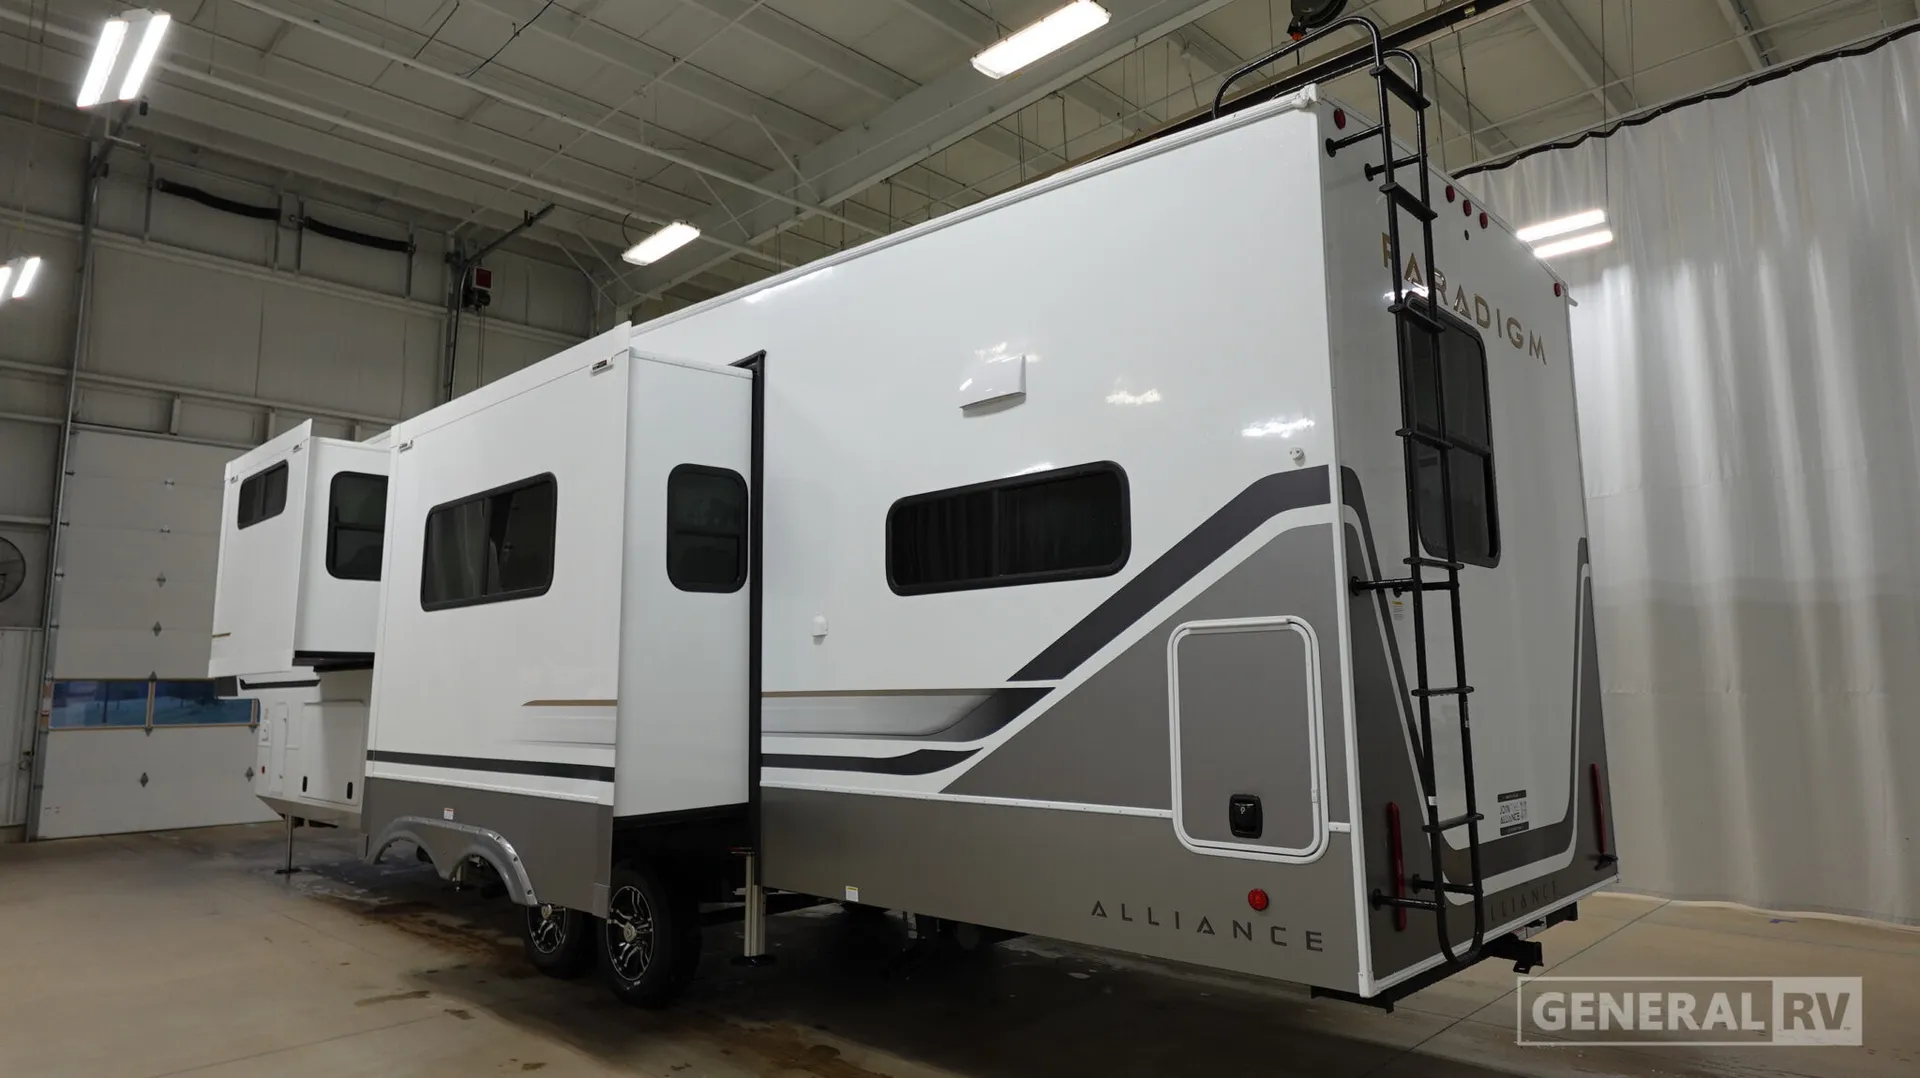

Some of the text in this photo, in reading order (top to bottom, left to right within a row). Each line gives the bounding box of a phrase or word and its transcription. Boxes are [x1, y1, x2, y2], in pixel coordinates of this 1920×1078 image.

[1381, 232, 1547, 365] PARADIGM
[1091, 900, 1323, 952] ALLIANCE
[1491, 880, 1557, 922] LLIANCE
